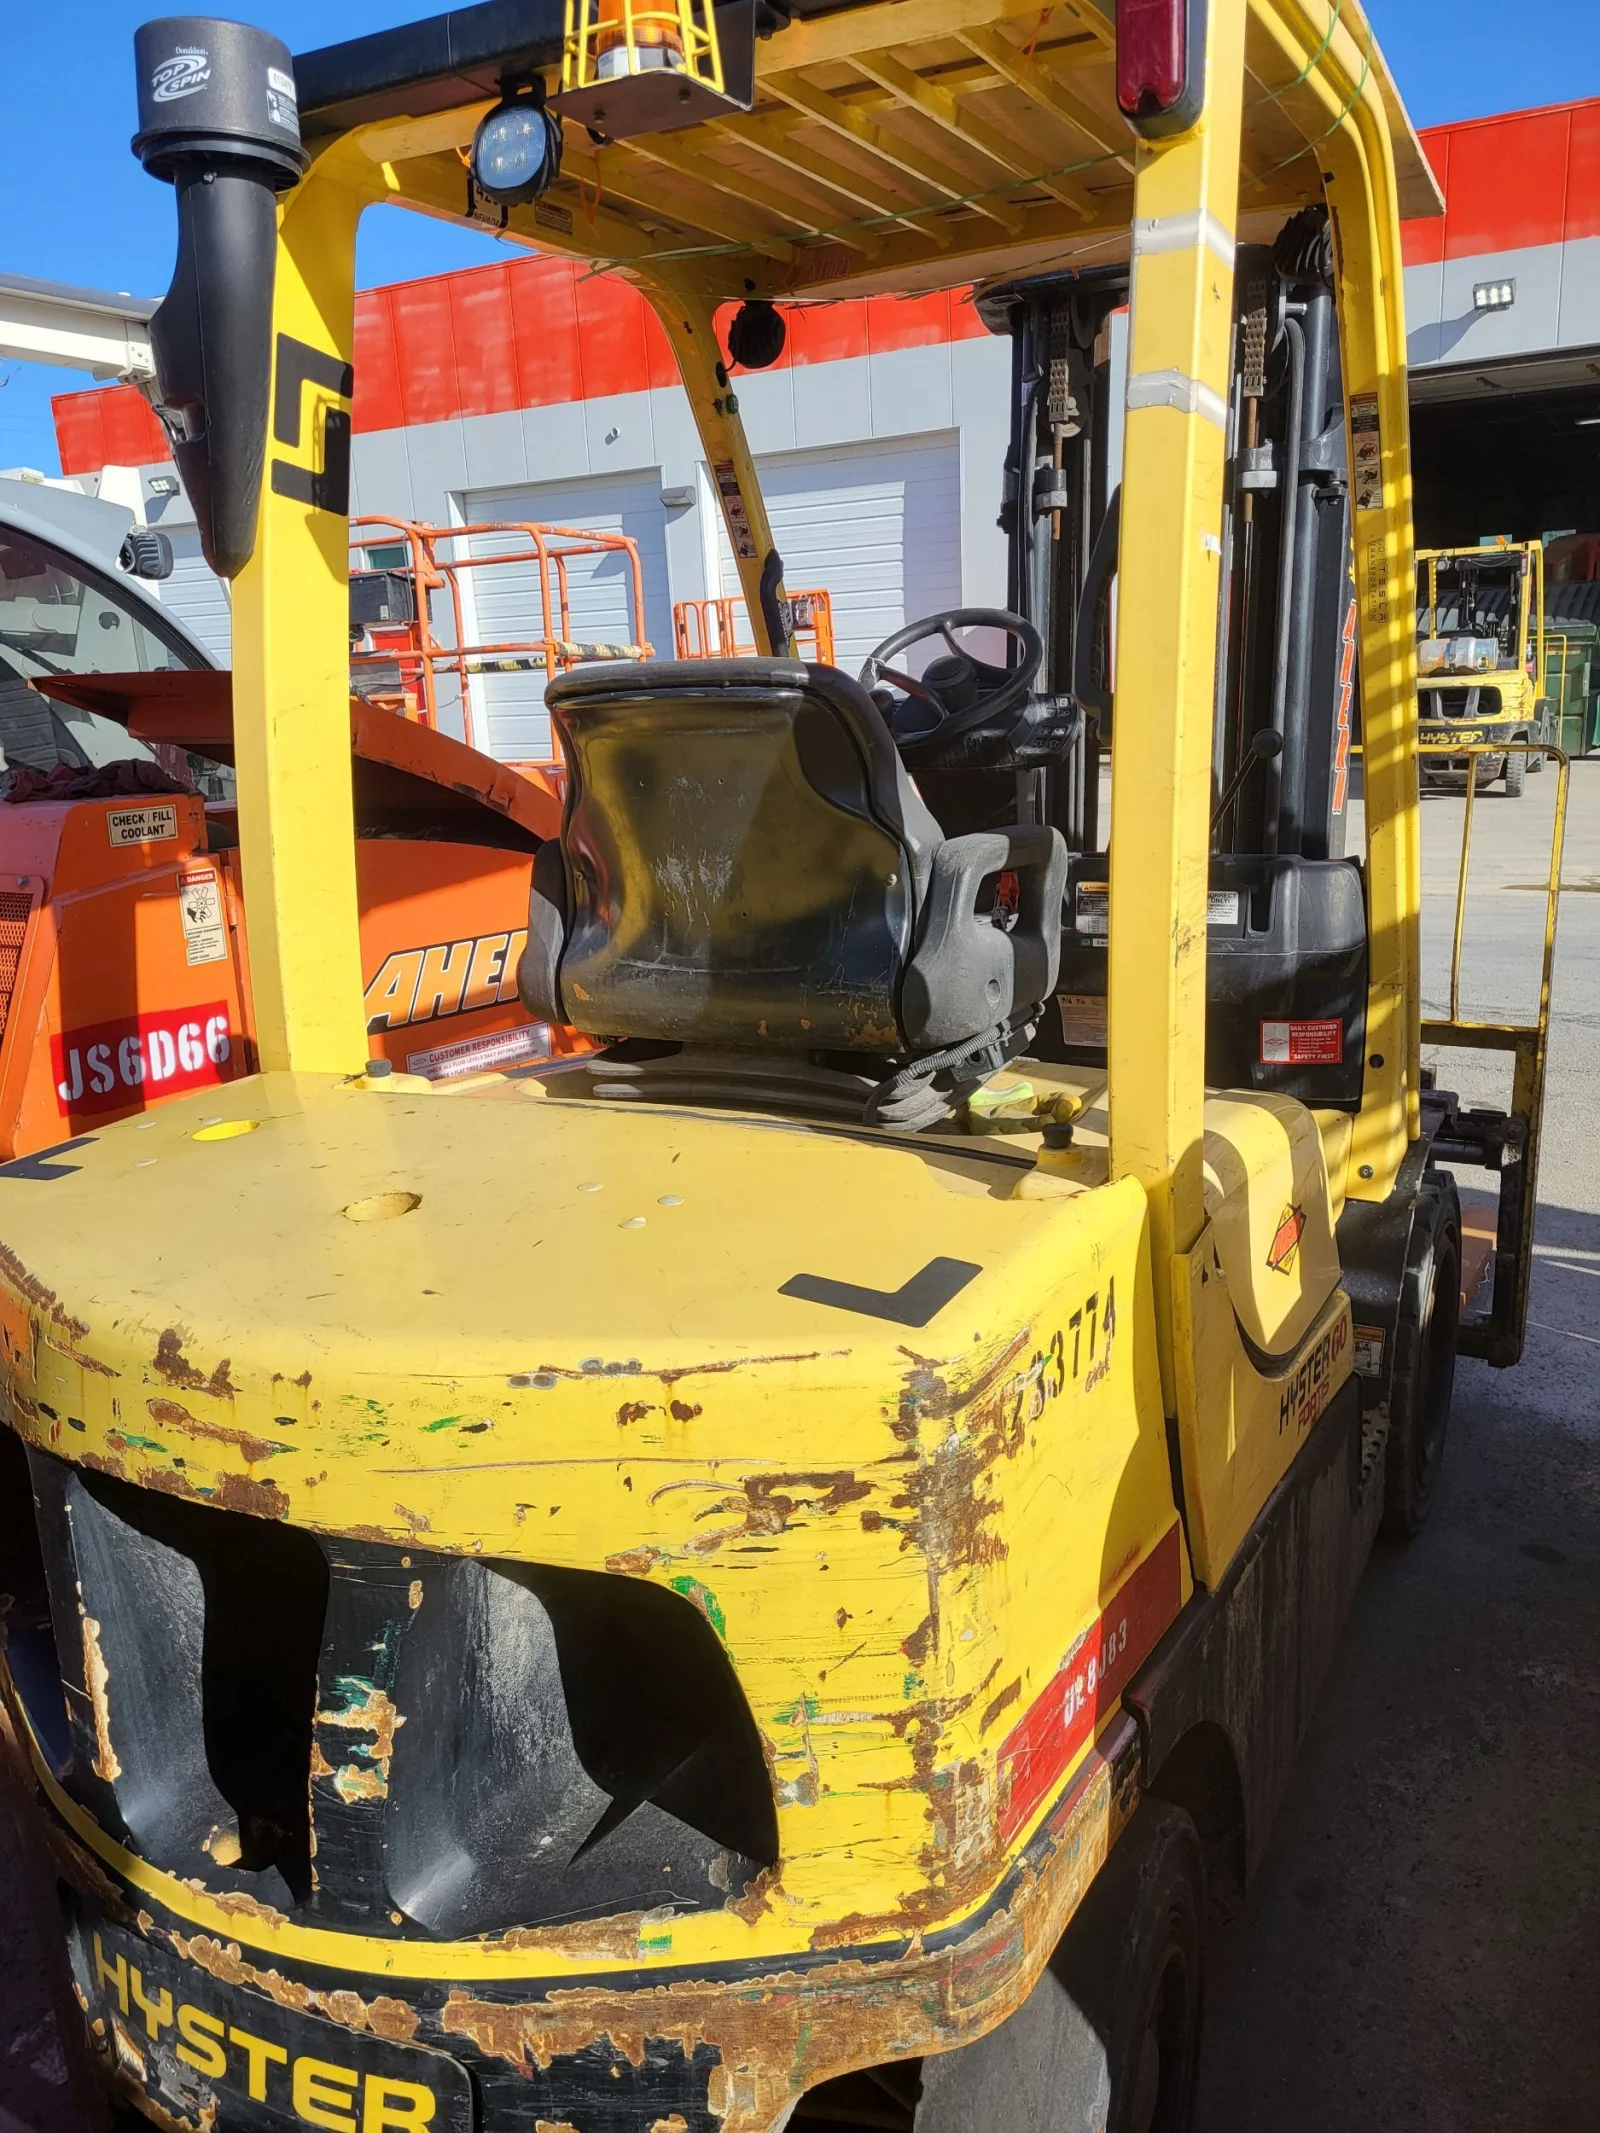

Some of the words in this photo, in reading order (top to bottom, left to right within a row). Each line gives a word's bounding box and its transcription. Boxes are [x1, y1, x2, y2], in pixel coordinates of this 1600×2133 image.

[175, 46, 206, 55] Donaldson
[152, 64, 185, 88] TOP
[170, 69, 211, 92] SPIN
[1369, 541, 1377, 621] TRANSPORTATION
[112, 813, 146, 827] CHECK
[152, 810, 173, 822] FILL
[121, 824, 166, 840] COOLANT
[187, 873, 214, 883] DANGER
[57, 1015, 231, 1101] JS6D66
[429, 1045, 471, 1063] CUSTOMER
[472, 1029, 531, 1051] RESPONSIBILITY
[1279, 1333, 1331, 1436] HYSTER
[93, 1929, 436, 2133] HYSTER
